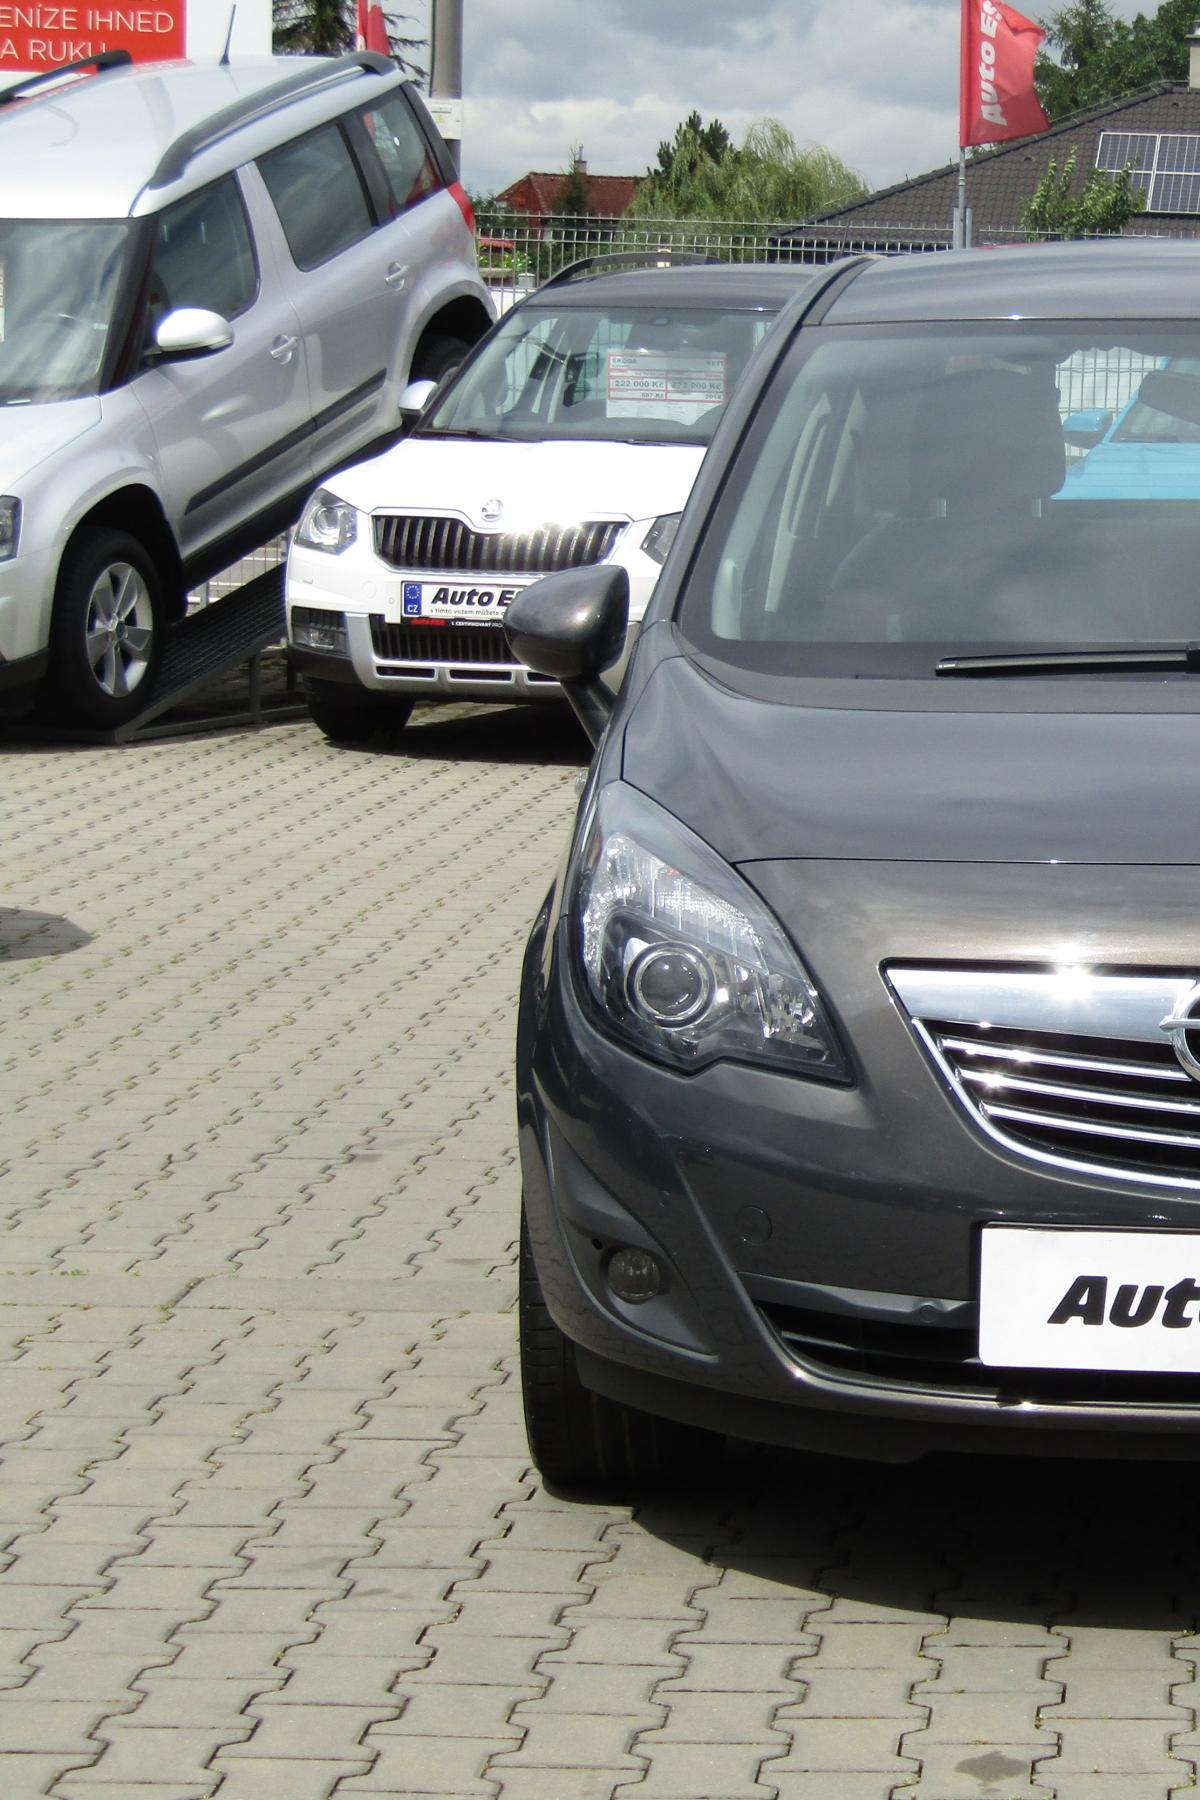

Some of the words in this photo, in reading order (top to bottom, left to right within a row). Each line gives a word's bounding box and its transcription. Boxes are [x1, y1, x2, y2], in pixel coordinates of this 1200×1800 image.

[88, 10, 174, 33] IHNED
[979, 41, 1008, 126] Auto
[633, 380, 650, 388] 000
[431, 587, 494, 607] Auto
[407, 604, 418, 613] CZ
